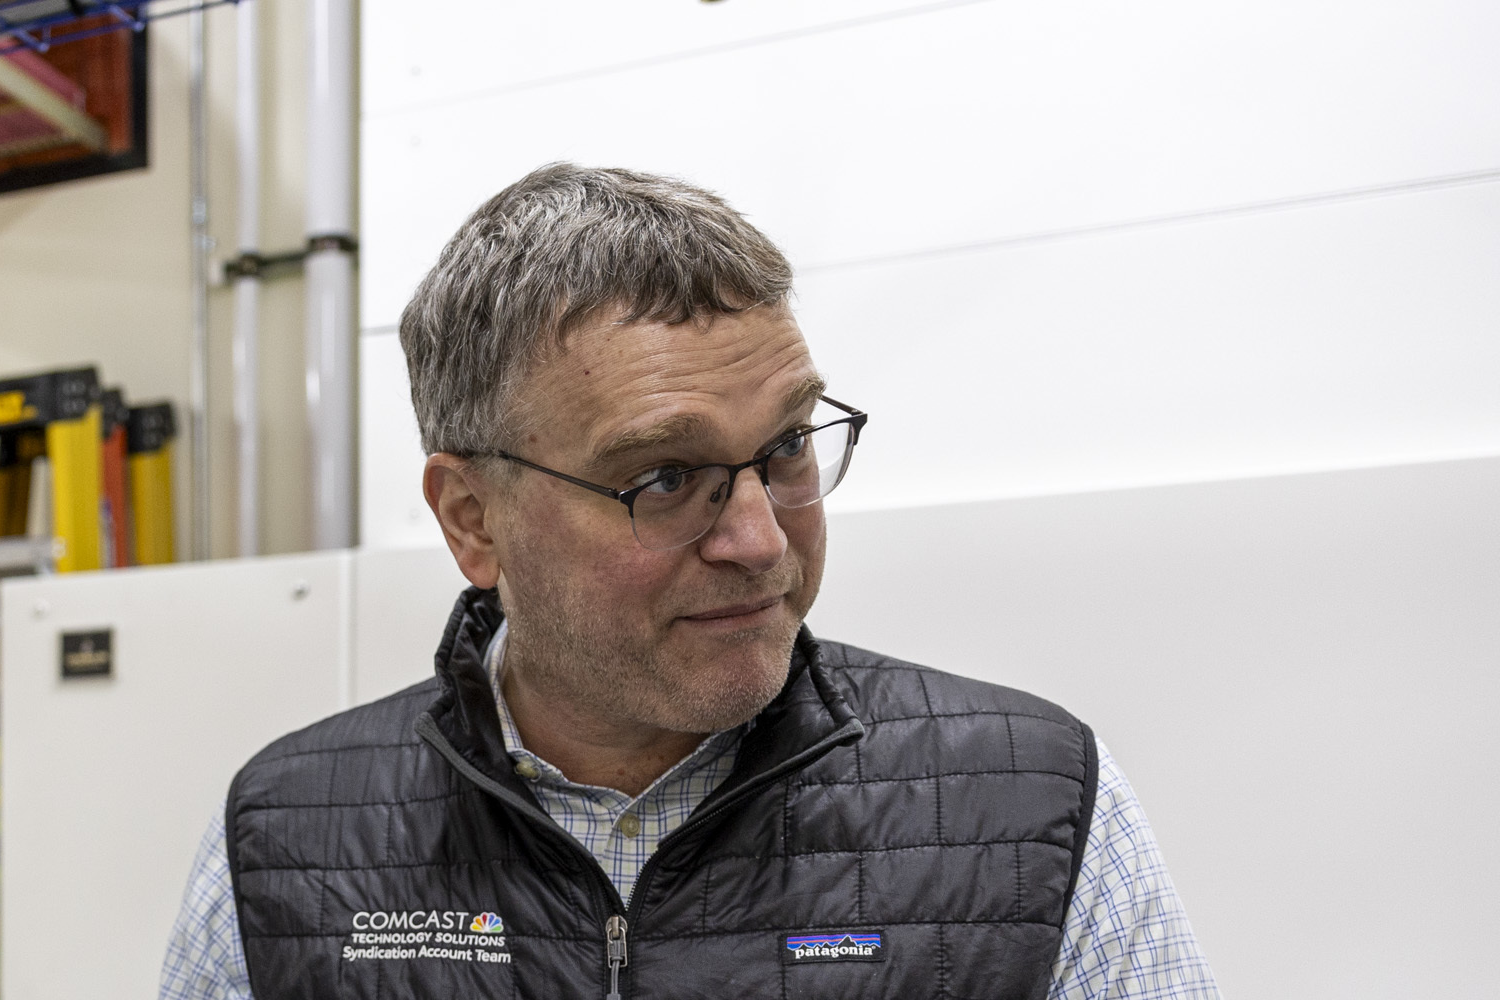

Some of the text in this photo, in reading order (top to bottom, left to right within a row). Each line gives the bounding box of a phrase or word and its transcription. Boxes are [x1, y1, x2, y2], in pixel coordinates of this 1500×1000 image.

[352, 910, 469, 930] COMCAST
[351, 932, 506, 947] TECHNOLOGY SOLUTIONS
[342, 944, 512, 964] Syndication Account Team
[794, 944, 873, 960] patagonia
